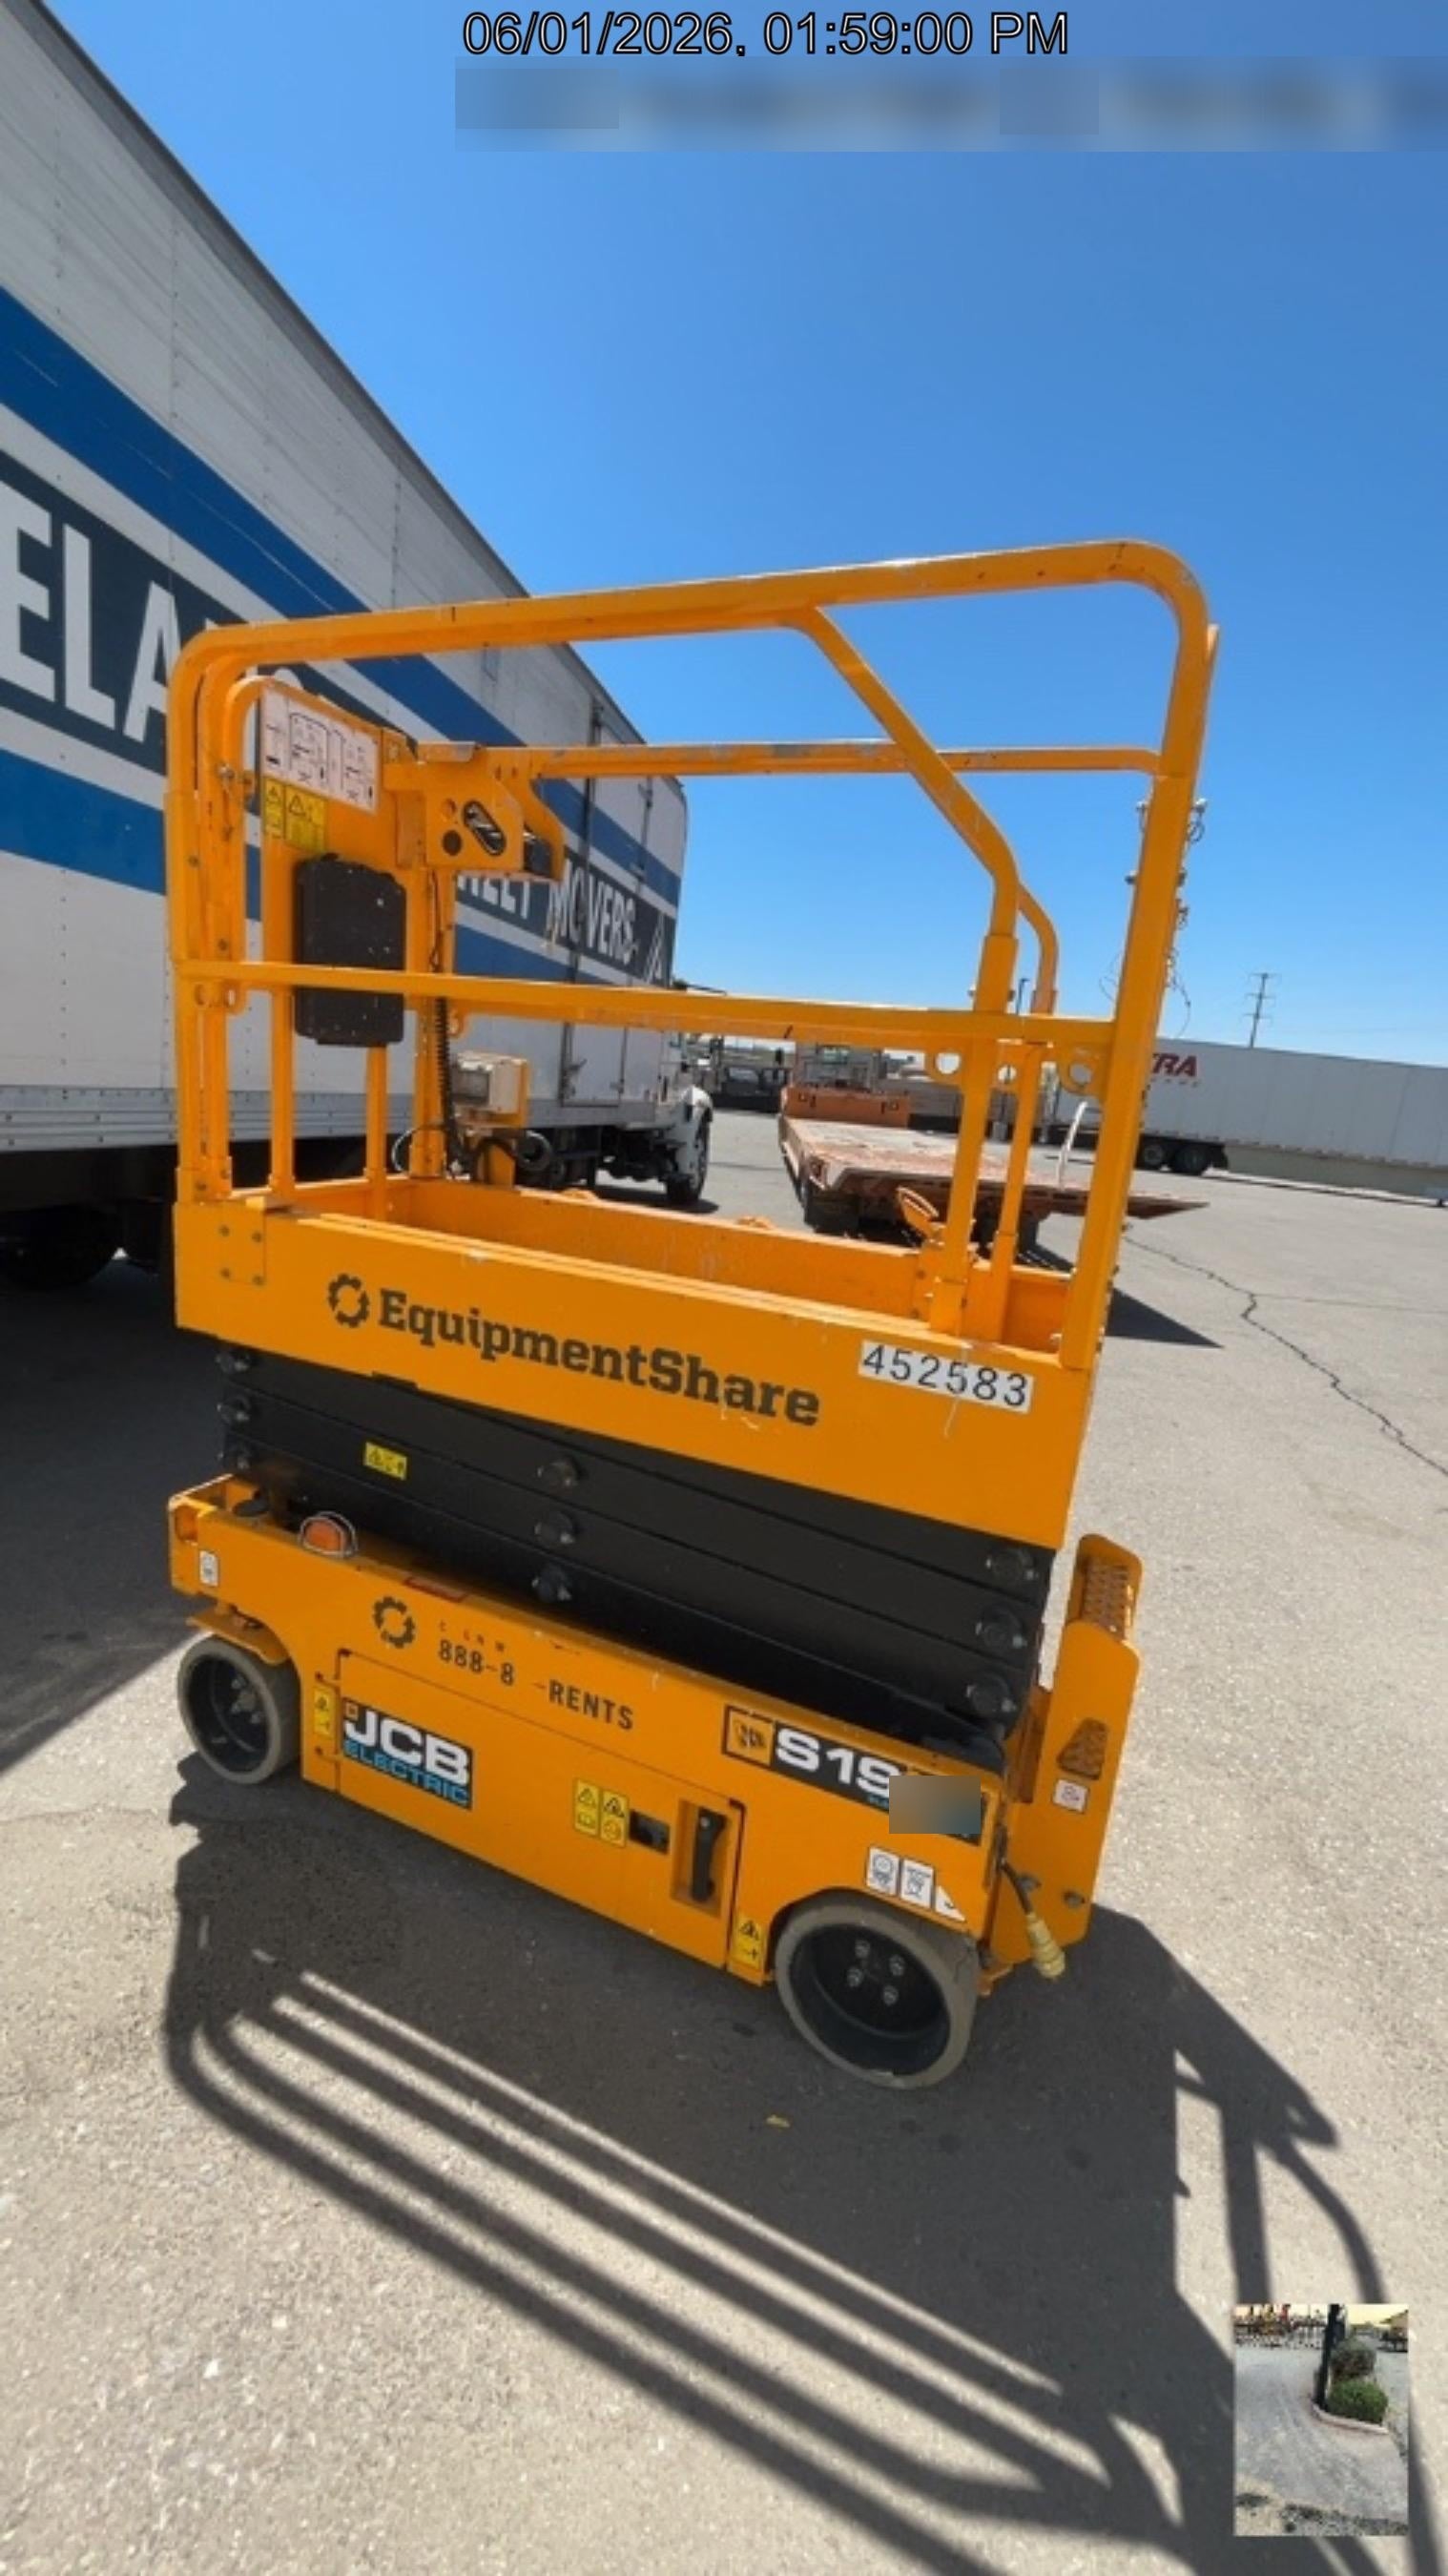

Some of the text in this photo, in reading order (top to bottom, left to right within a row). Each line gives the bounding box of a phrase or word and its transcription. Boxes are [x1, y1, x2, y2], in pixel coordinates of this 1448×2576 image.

[0, 480, 176, 744] ELA
[379, 1288, 820, 1426] EquipmentShare
[863, 1344, 1028, 1407] 452583
[344, 1710, 470, 1786] JCB
[344, 1737, 470, 1806] ELECTRIC
